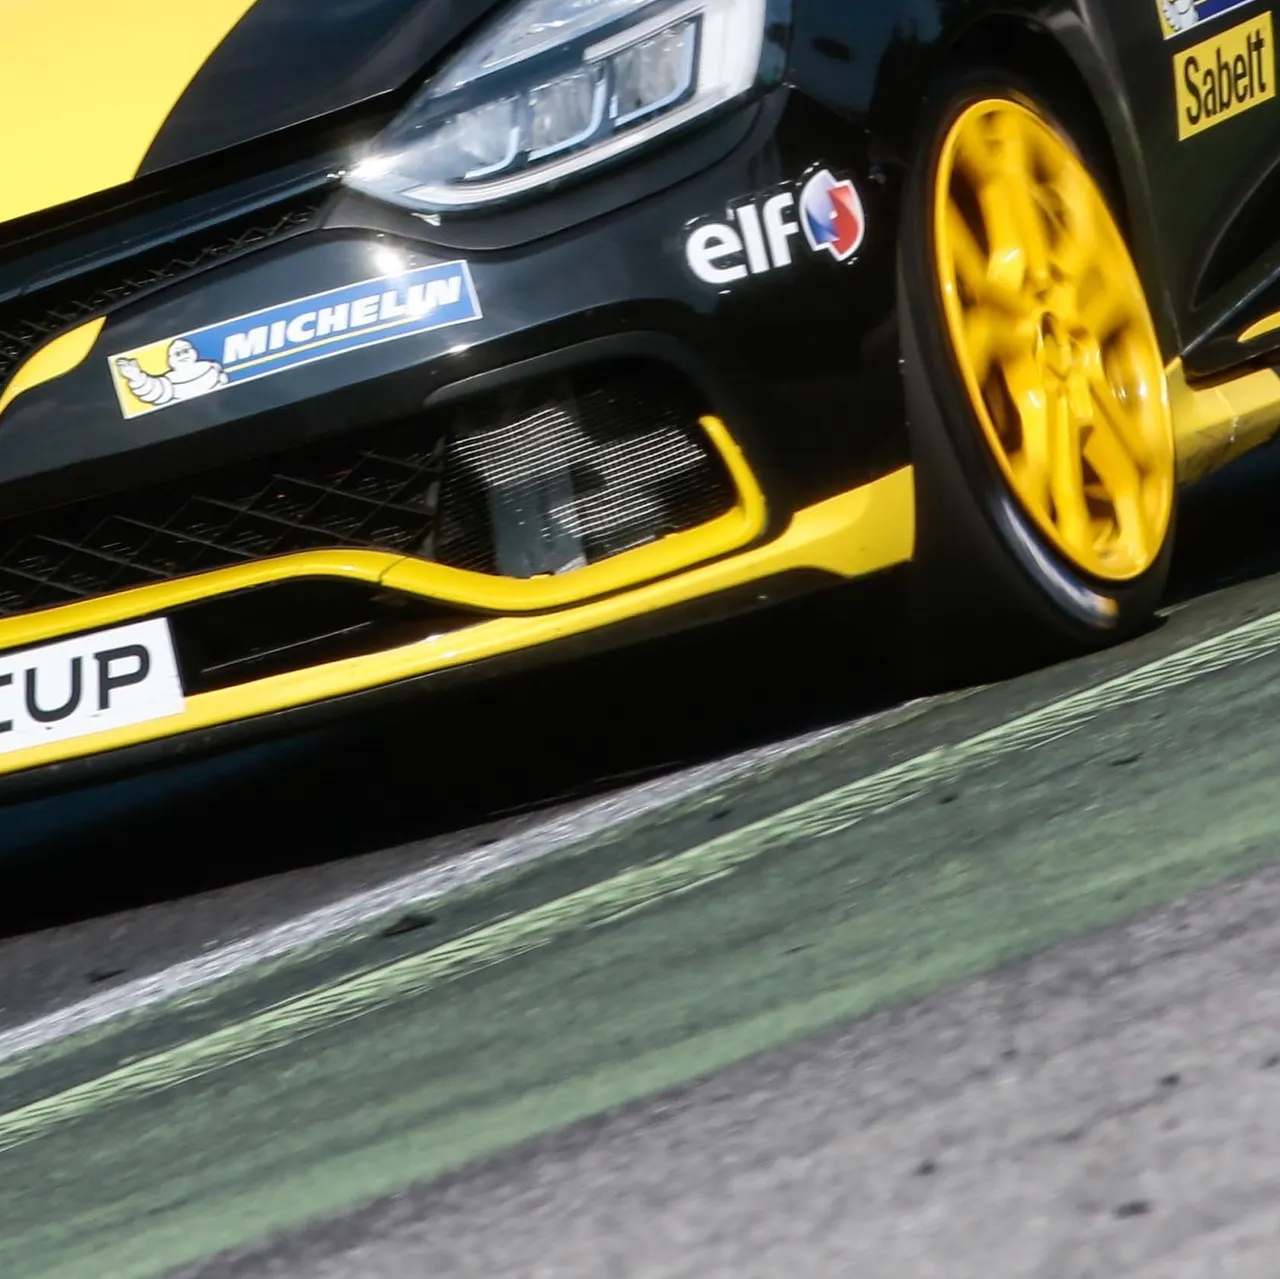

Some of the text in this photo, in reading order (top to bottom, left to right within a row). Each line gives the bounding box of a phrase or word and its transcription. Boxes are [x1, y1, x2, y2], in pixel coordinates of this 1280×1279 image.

[1184, 28, 1267, 126] Sabelt
[686, 192, 800, 284] elf
[223, 275, 461, 365] MICHELIN
